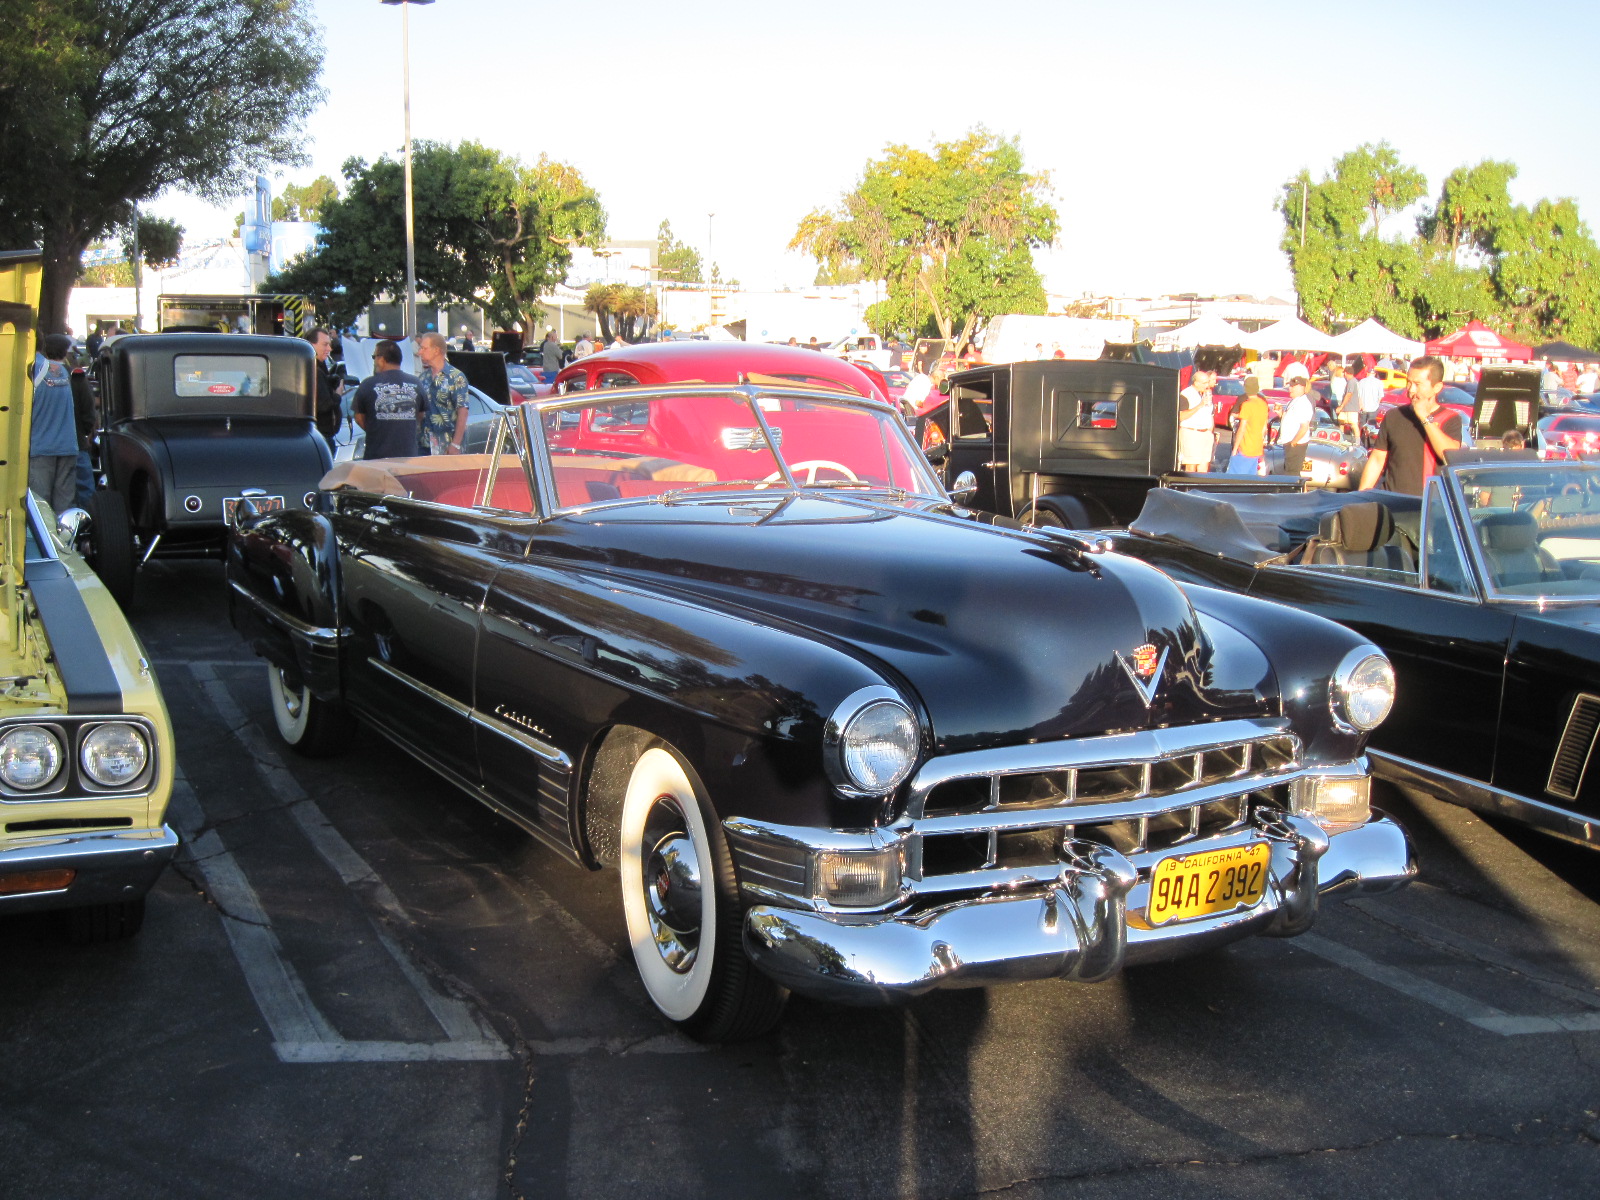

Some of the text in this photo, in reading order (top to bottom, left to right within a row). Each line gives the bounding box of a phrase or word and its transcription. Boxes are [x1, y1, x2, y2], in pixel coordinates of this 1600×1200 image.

[1165, 847, 1261, 872] 19 CALIFORNIA 47
